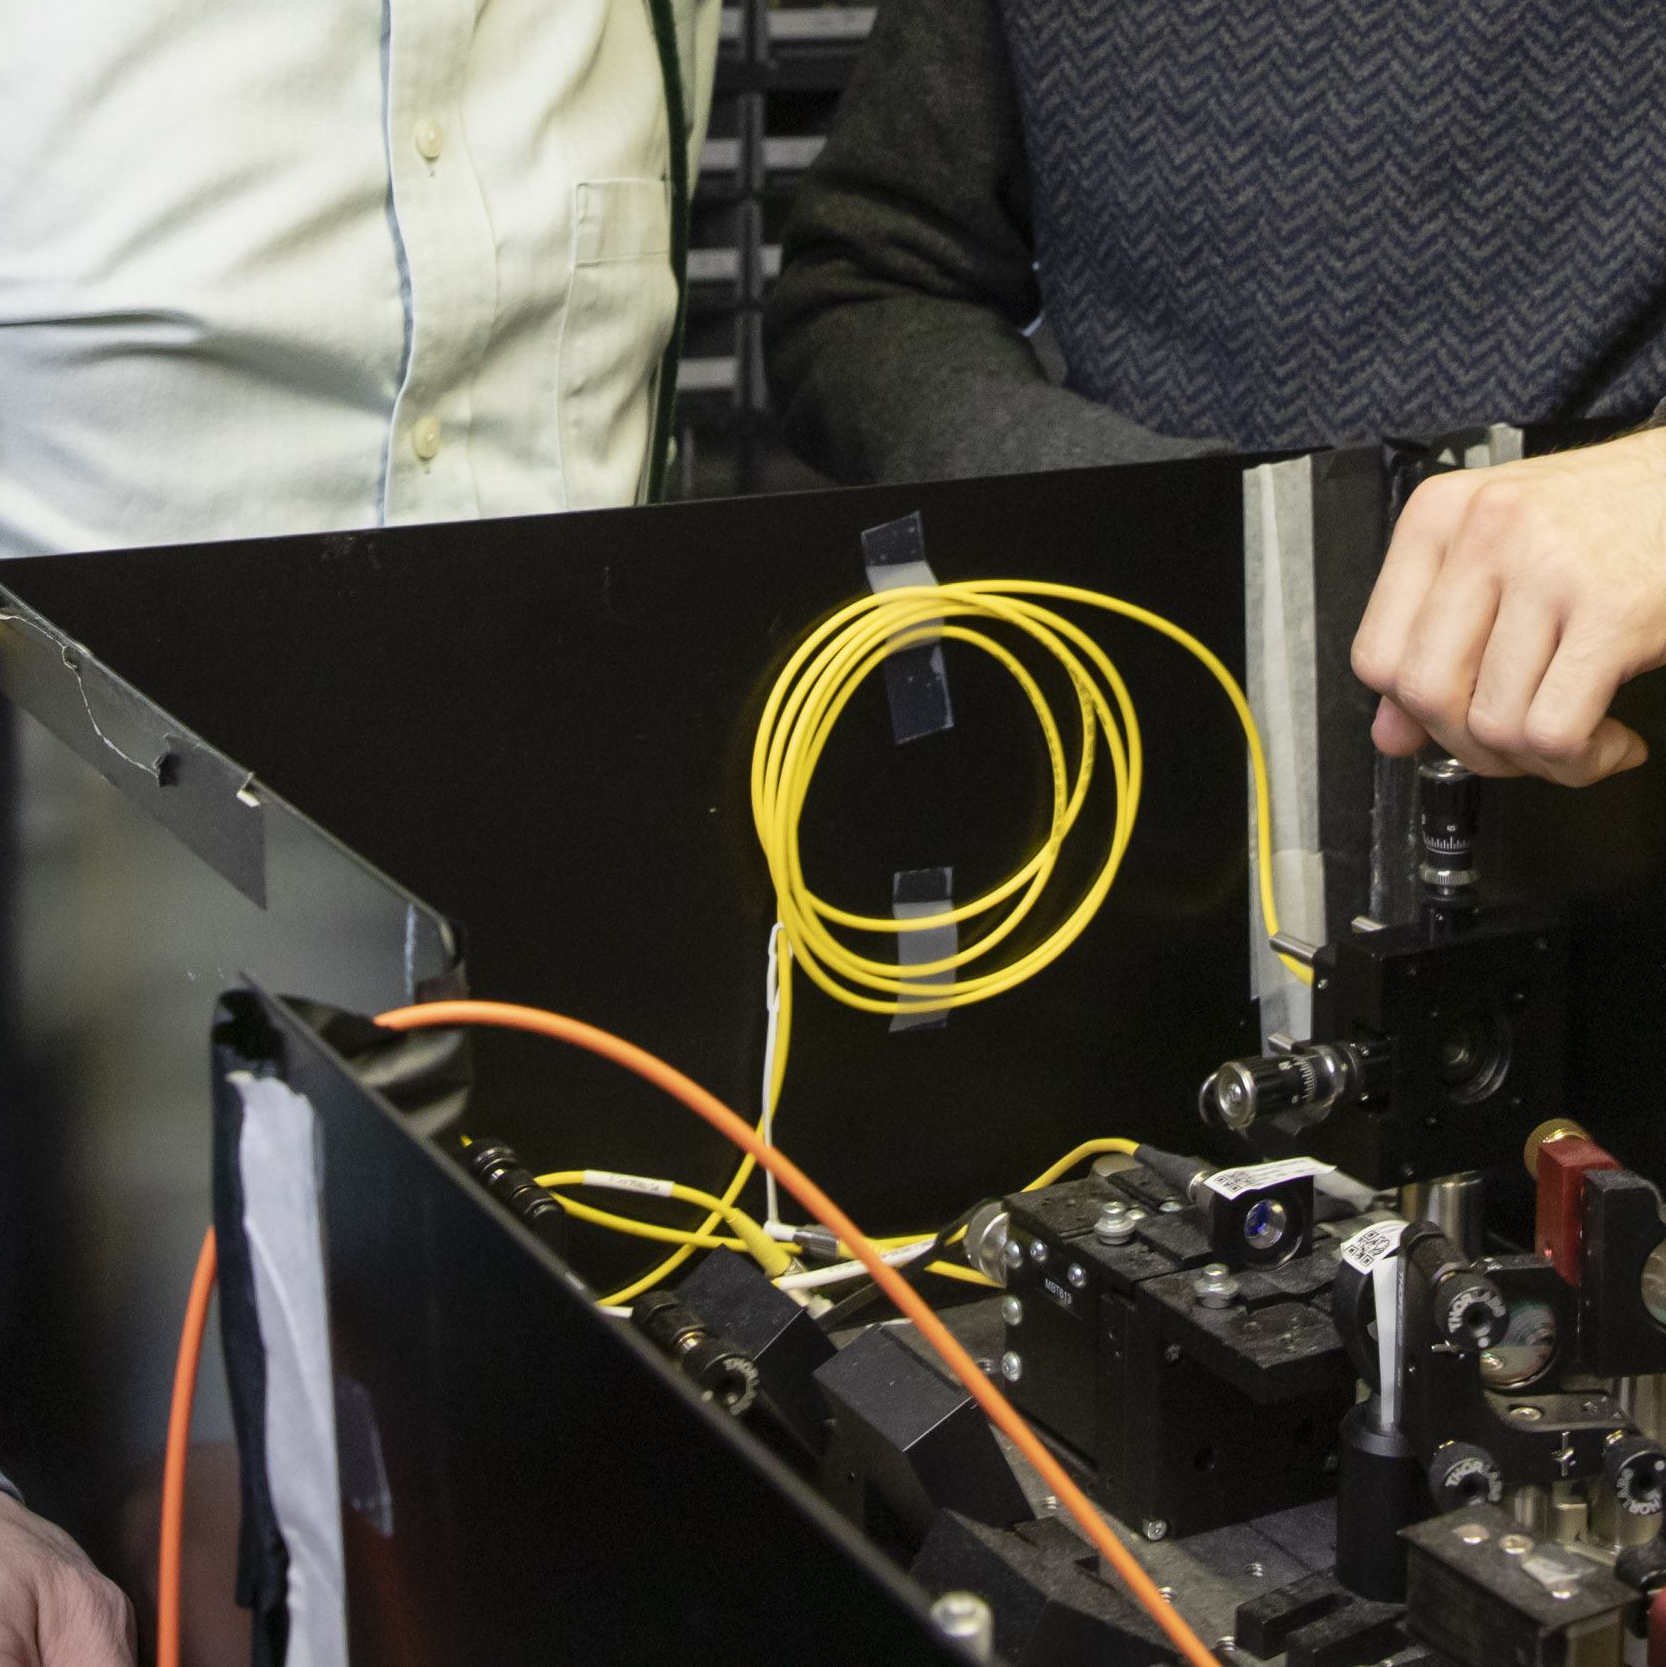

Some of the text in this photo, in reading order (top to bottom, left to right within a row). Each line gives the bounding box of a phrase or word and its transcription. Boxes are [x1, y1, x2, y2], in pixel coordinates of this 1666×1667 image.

[1447, 1290, 1507, 1333] THORLABS
[1444, 1460, 1502, 1503] THORLABS
[1616, 1468, 1662, 1515] HORLABS
